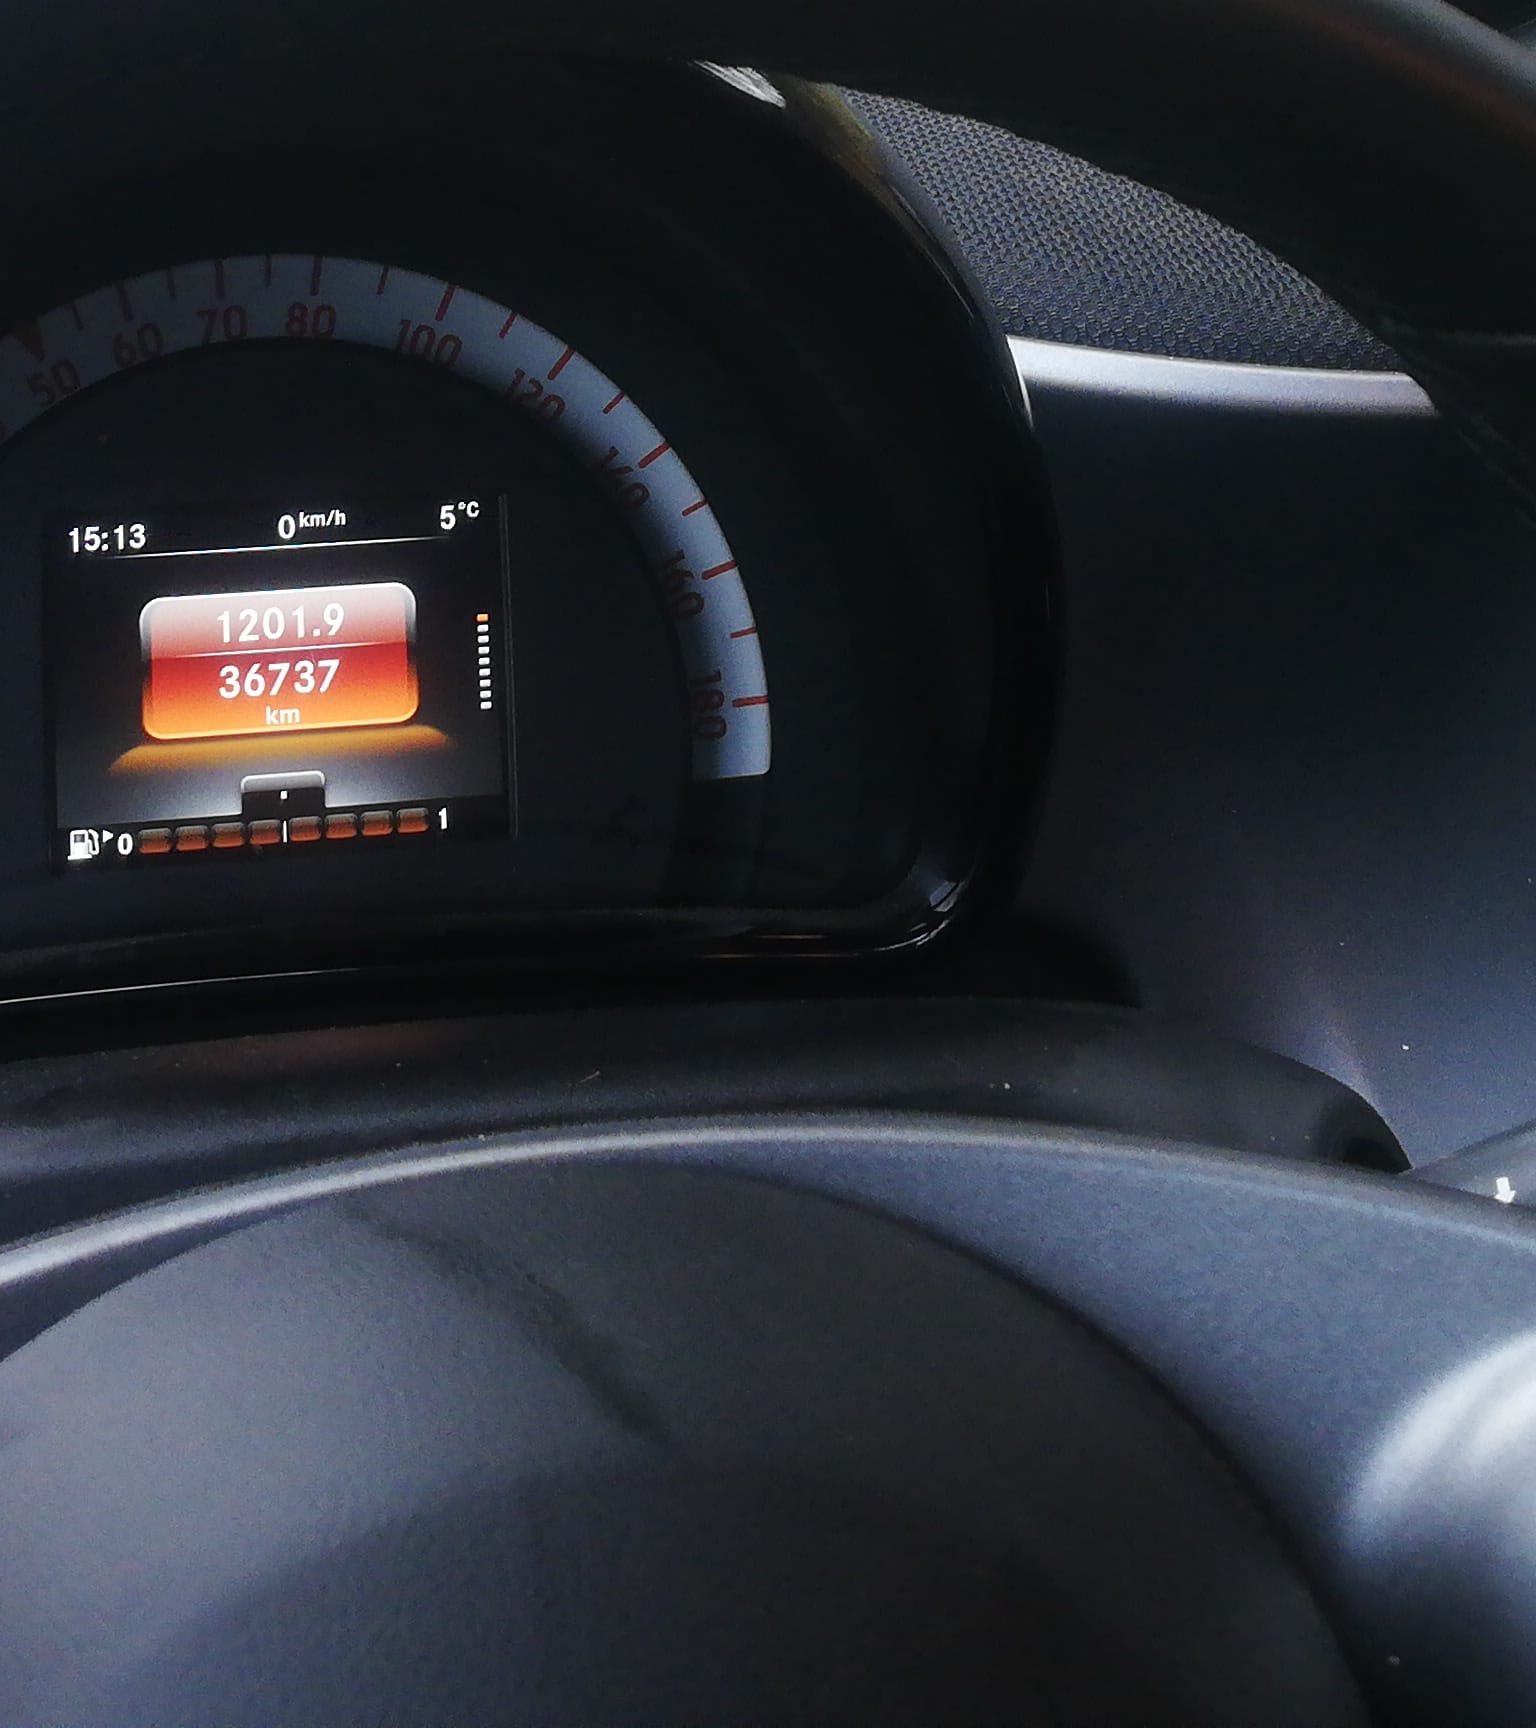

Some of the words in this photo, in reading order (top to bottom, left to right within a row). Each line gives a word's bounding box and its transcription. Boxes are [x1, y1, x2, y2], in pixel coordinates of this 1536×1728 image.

[195, 303, 249, 345] 70
[285, 301, 337, 339] 80
[111, 322, 163, 370] 60
[394, 318, 463, 370] 100
[26, 358, 80, 408] 50
[504, 367, 566, 422] 120
[68, 524, 147, 553] 15:13
[216, 603, 346, 644] 1201.9
[218, 659, 341, 699] 36737
[265, 704, 302, 726] km
[690, 670, 728, 740] 180
[438, 808, 448, 830] 1
[117, 831, 134, 856] 0
